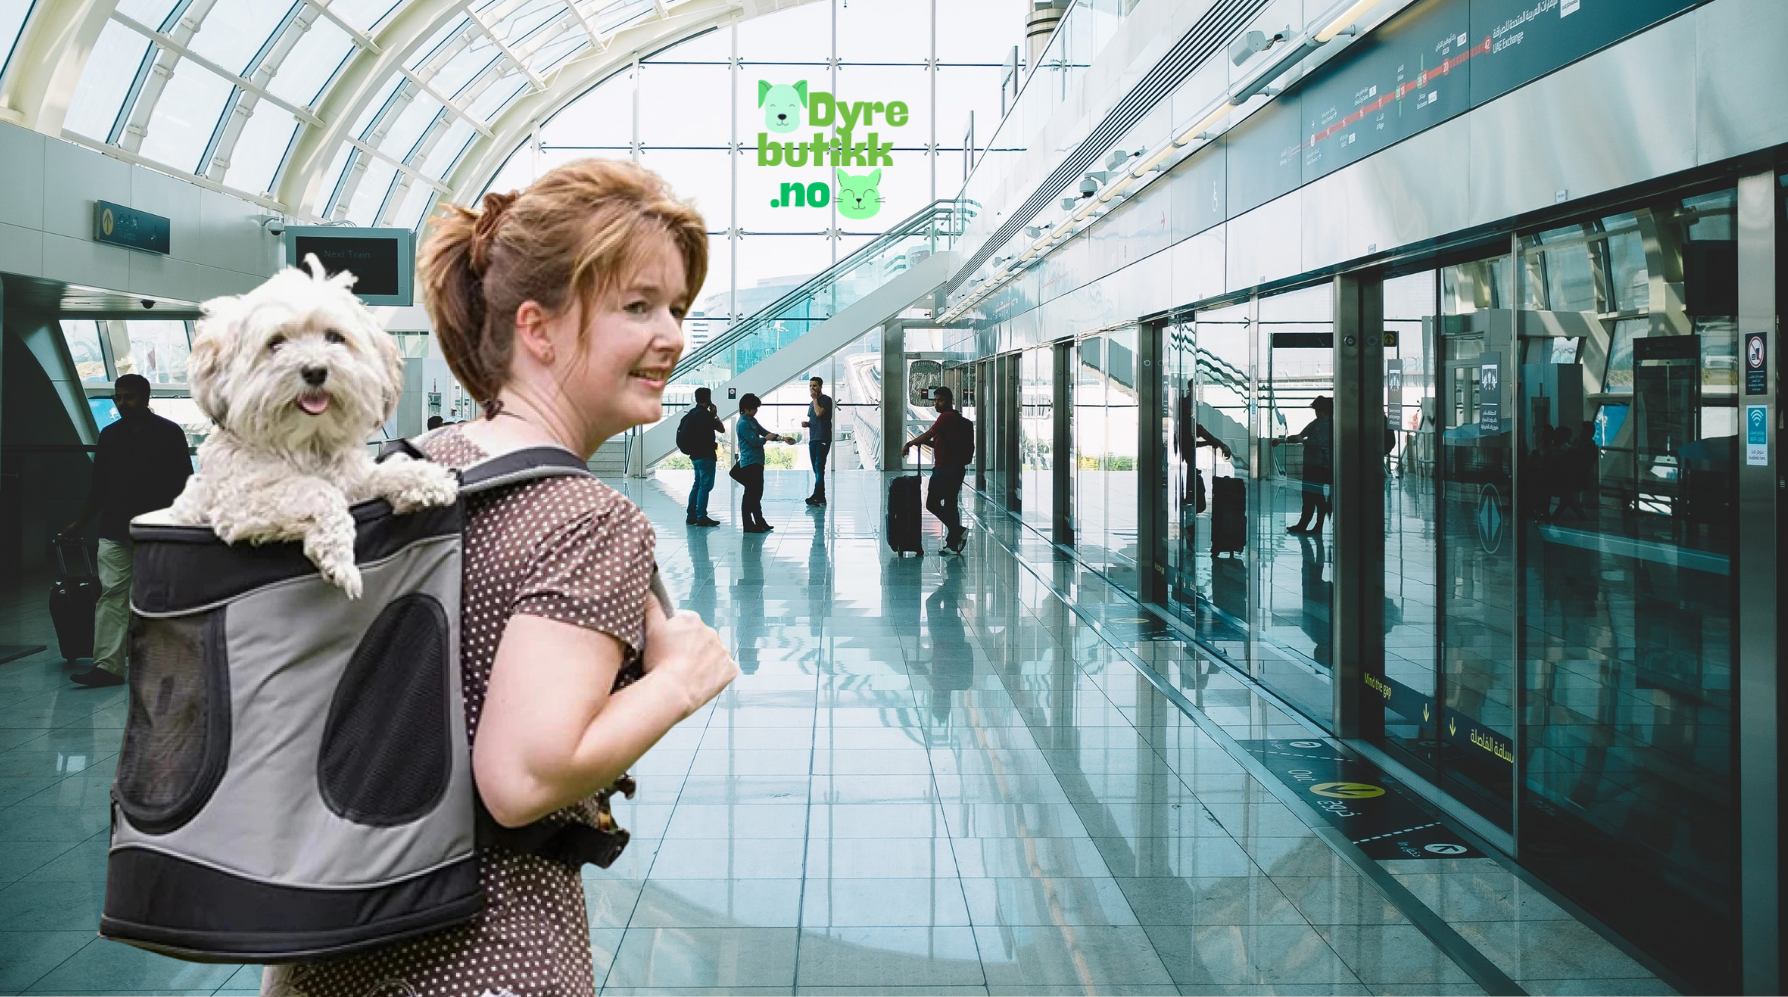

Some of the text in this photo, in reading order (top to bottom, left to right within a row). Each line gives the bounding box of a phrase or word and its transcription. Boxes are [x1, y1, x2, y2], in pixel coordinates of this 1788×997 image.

[1502, 31, 1524, 50] Exchange
[324, 250, 371, 259] Next Train
[1364, 672, 1375, 689] Mind
[1383, 684, 1392, 700] gap
[1287, 769, 1317, 782] Out
